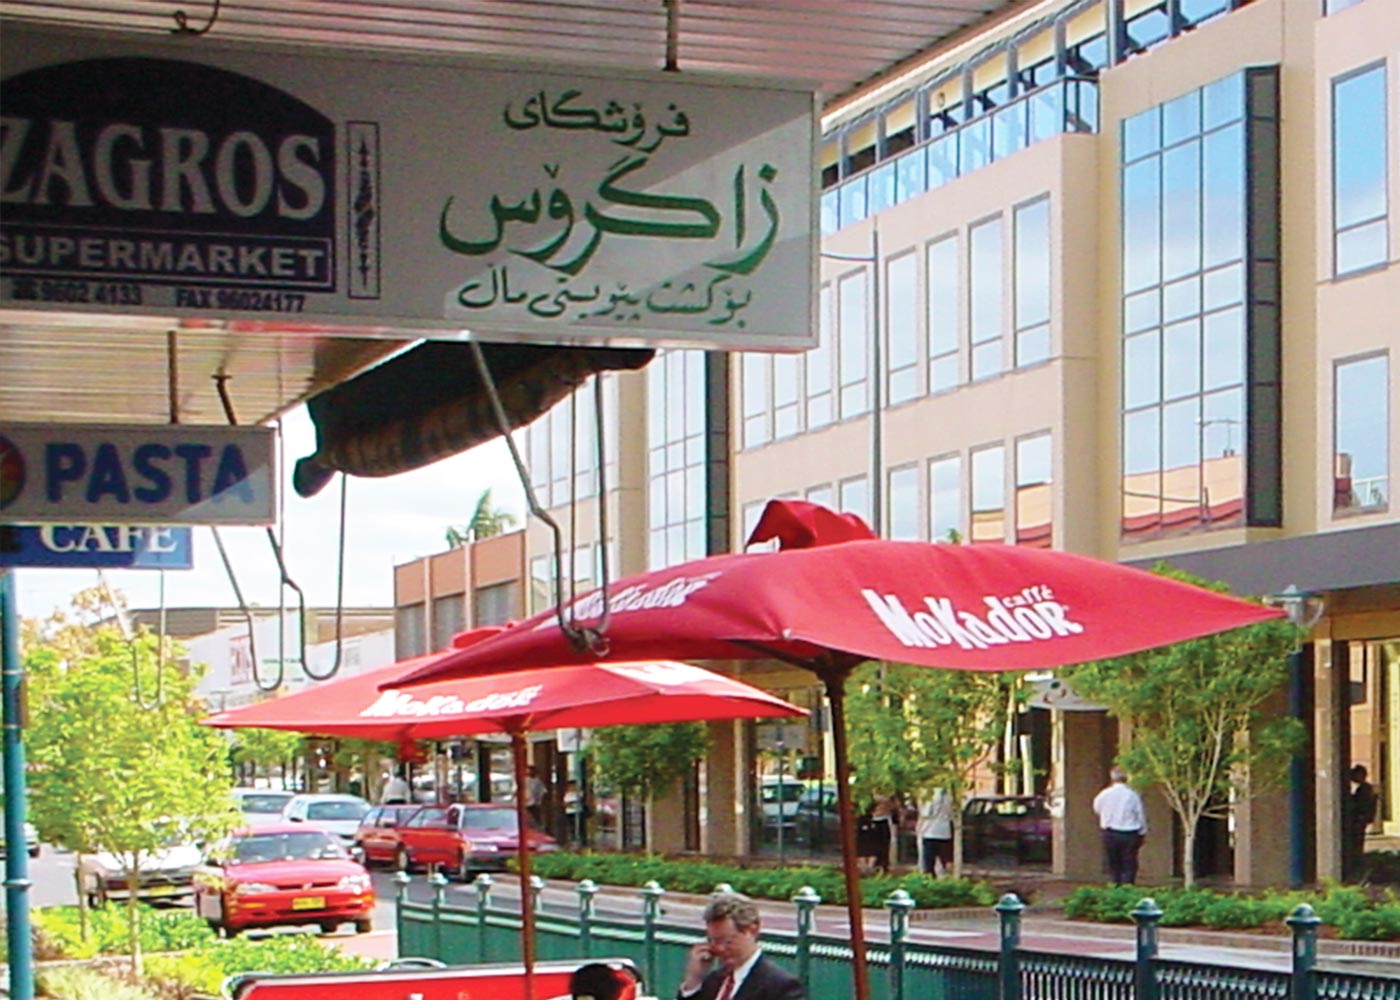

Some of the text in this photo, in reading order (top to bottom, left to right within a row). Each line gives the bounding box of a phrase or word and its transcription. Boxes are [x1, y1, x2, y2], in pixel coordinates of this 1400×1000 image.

[0, 116, 326, 220] ZAGROS
[0, 232, 323, 277] SUPERMARKET
[175, 286, 212, 310] FAX
[45, 443, 258, 504] PASTA
